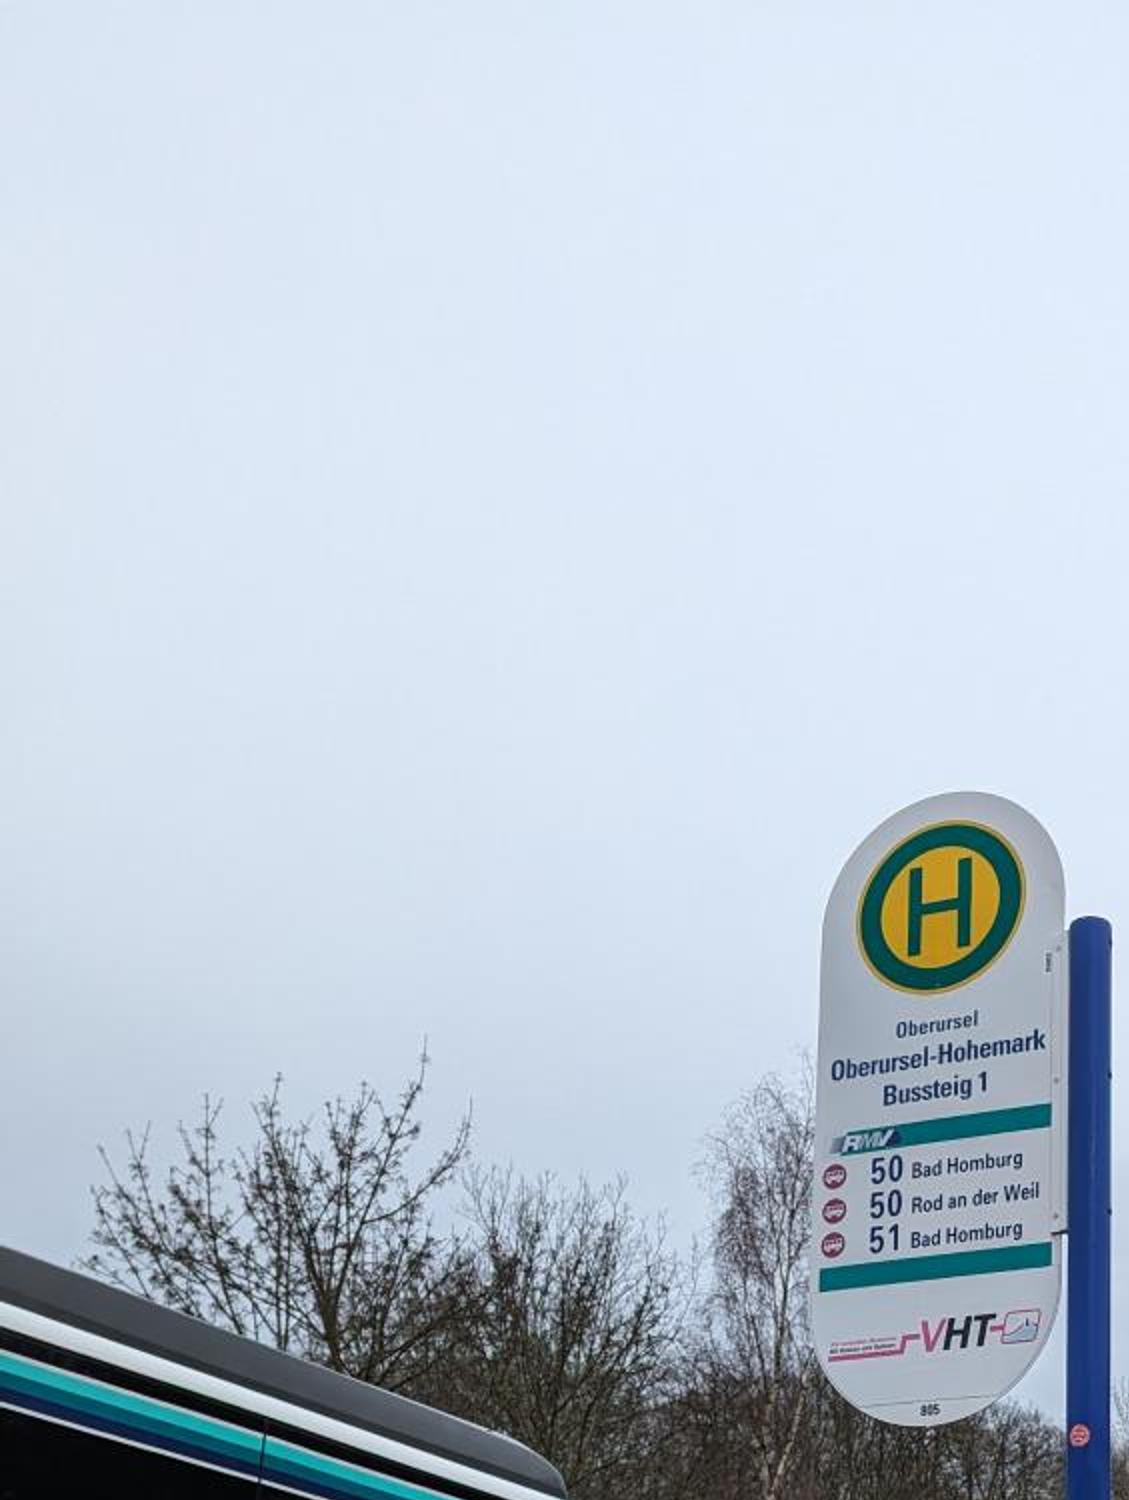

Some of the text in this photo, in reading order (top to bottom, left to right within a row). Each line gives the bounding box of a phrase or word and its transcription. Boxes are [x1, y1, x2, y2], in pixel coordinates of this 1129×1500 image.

[908, 857, 973, 957] H
[896, 1010, 979, 1038] Oberursel
[831, 1029, 1046, 1081] Oberursel-Hohemark
[883, 1071, 988, 1106] Bussteig 1
[842, 1128, 896, 1153] RMV
[870, 1151, 1023, 1185] 50 Bad Homburg
[869, 1182, 1040, 1220] 50 Rod an der Weil
[868, 1221, 1023, 1254] 51 Bad Homburg
[920, 1312, 997, 1352] VHT
